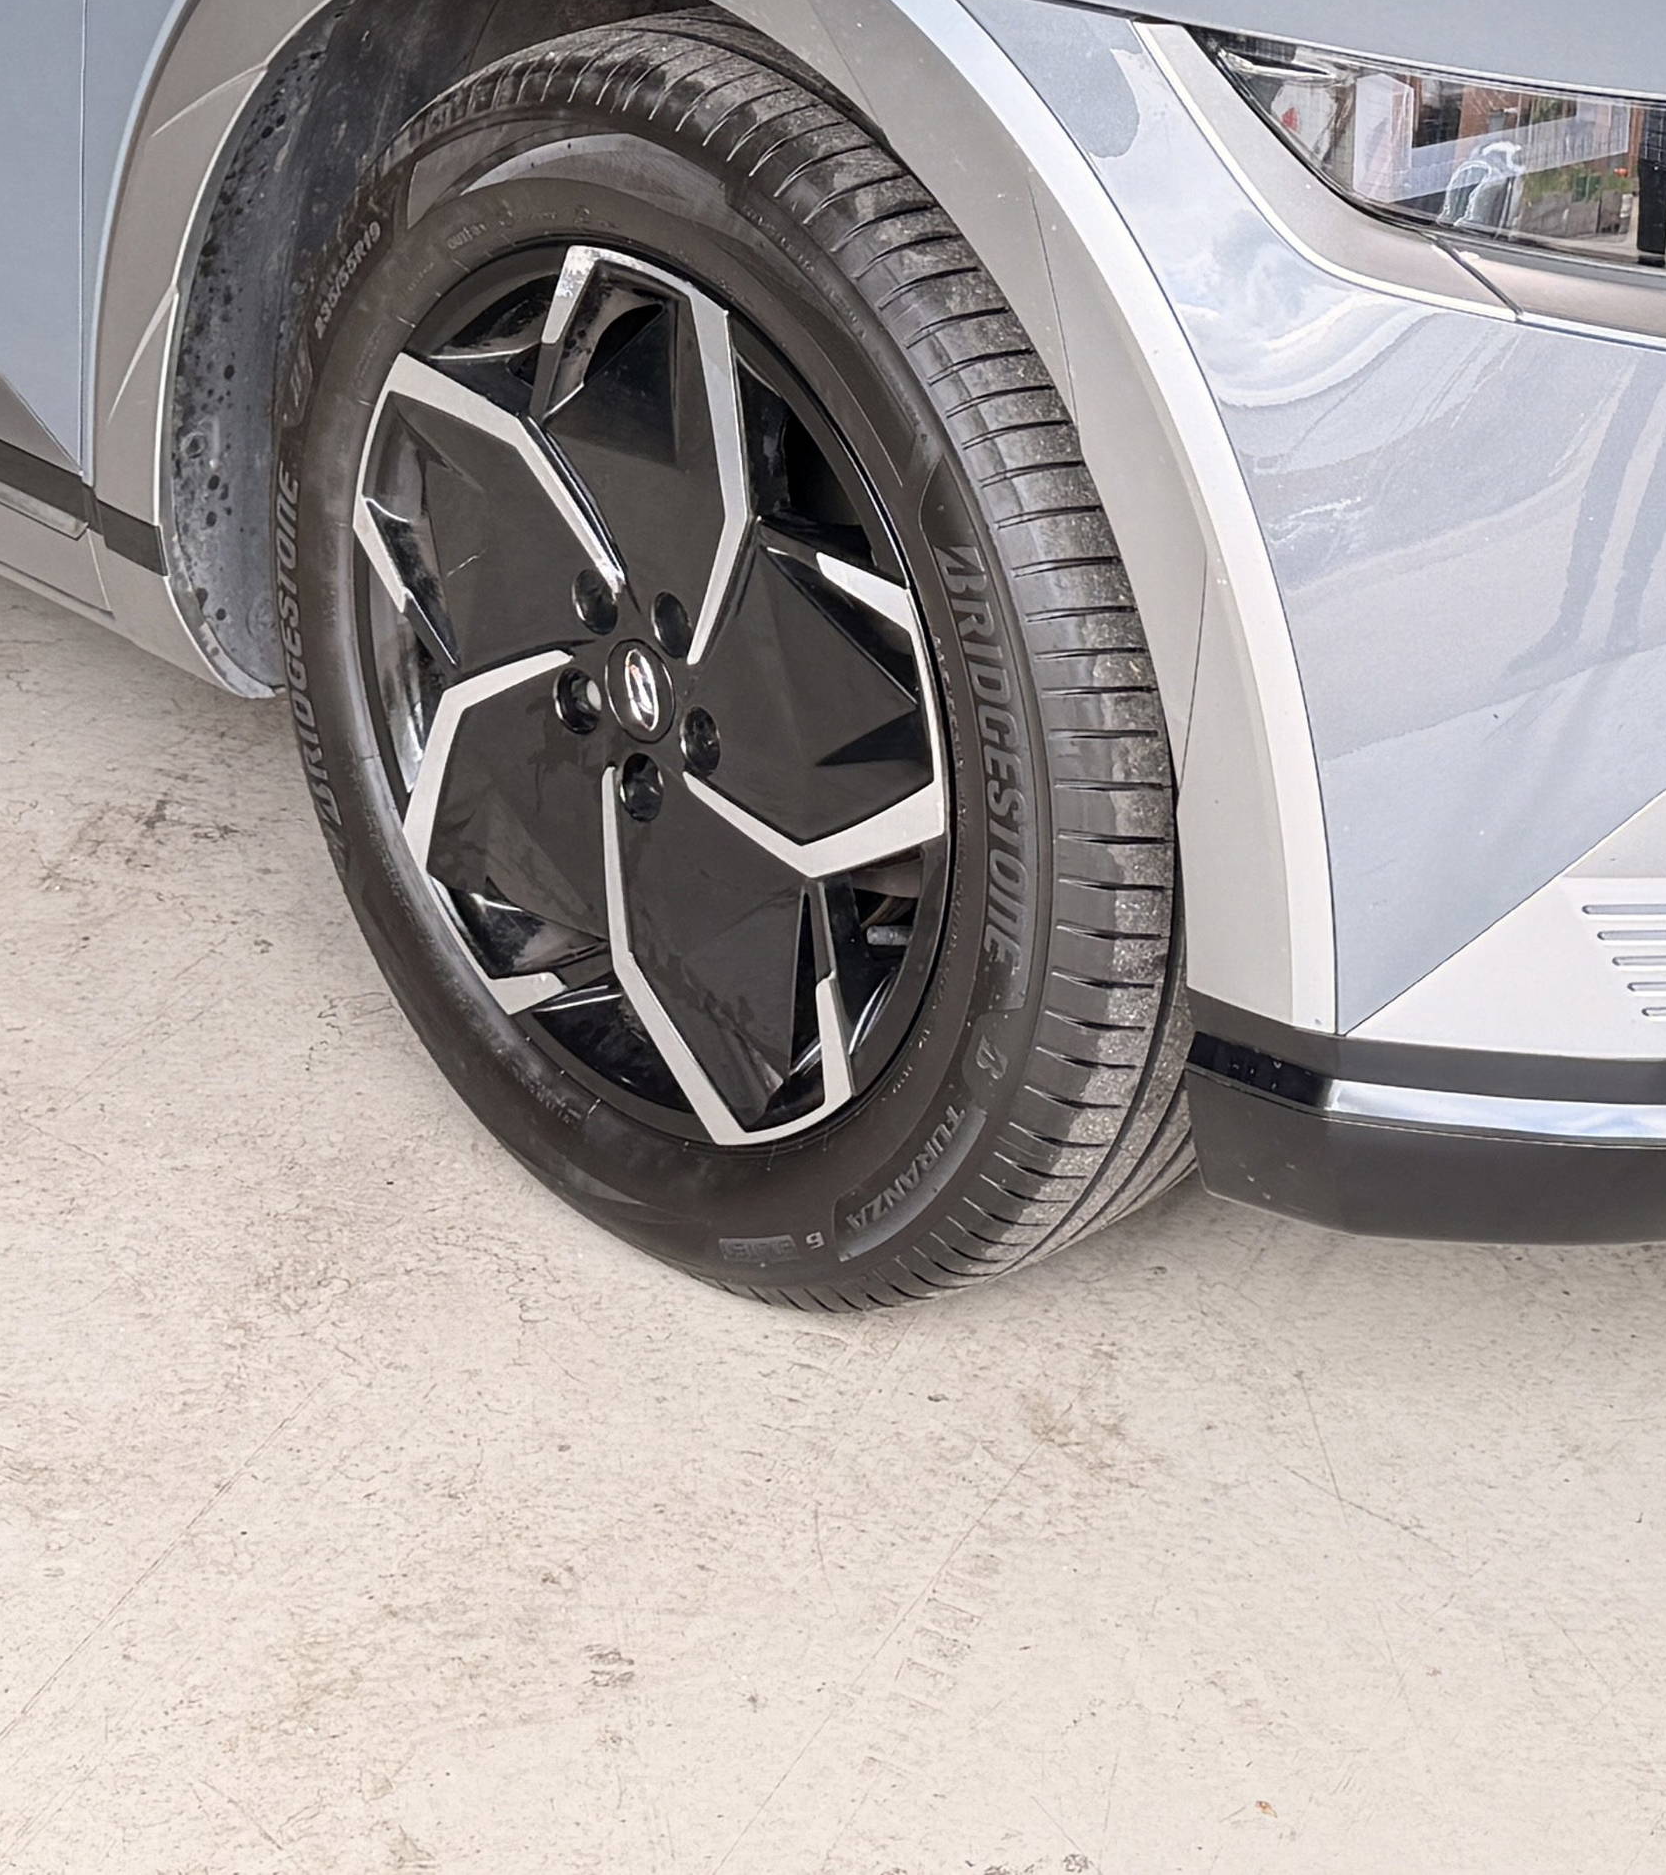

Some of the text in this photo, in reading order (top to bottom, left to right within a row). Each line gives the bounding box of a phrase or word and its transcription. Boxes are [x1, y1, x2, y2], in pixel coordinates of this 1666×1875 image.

[275, 461, 342, 826] BRIDGESTONE
[935, 545, 1030, 974] BRIDGESTONE
[845, 1105, 966, 1231] TURANZA
